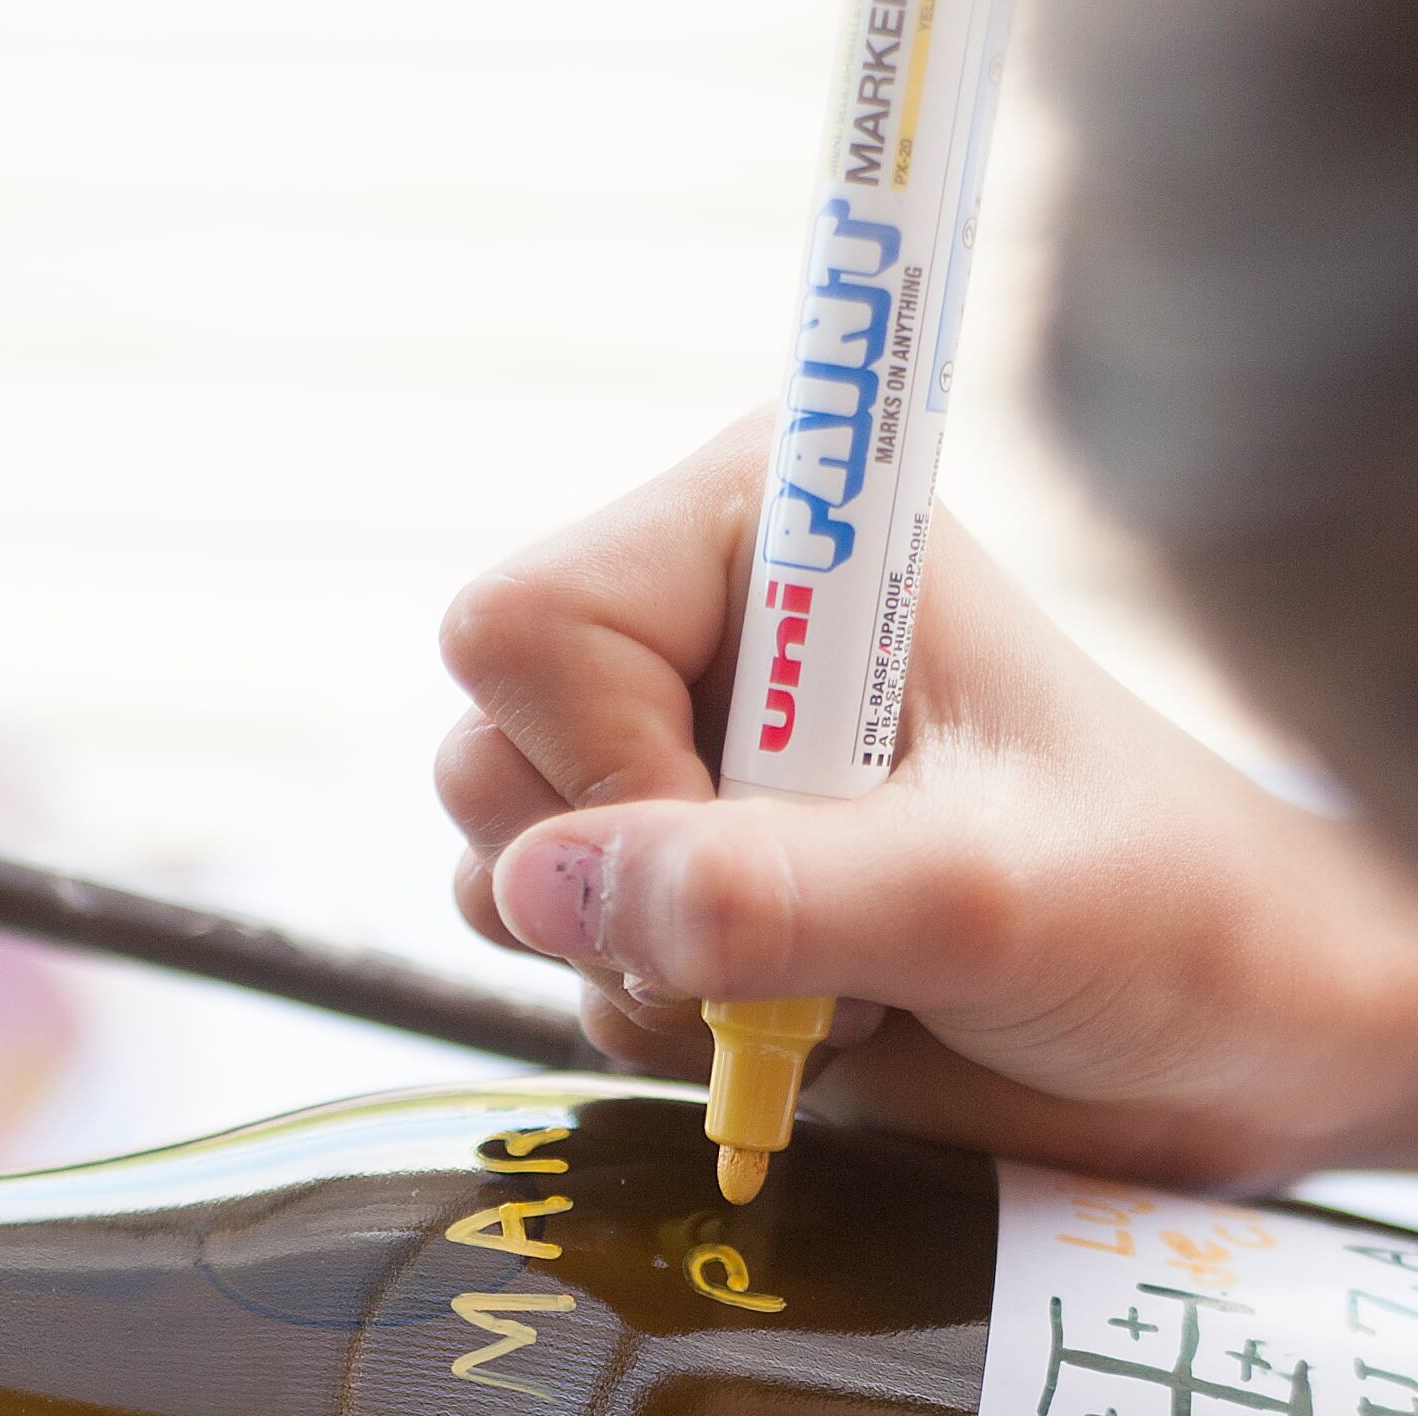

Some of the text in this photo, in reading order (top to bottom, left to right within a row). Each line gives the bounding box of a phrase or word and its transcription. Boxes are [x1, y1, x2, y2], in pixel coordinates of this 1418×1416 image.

[844, 0, 908, 187] MARKE
[894, 0, 936, 186] PX-20 YEL
[875, 265, 922, 465] MARKS ON ANYTHING
[758, 199, 901, 753] uni PAINT
[882, 678, 898, 721] BASE
[445, 1126, 576, 1402] MAR
